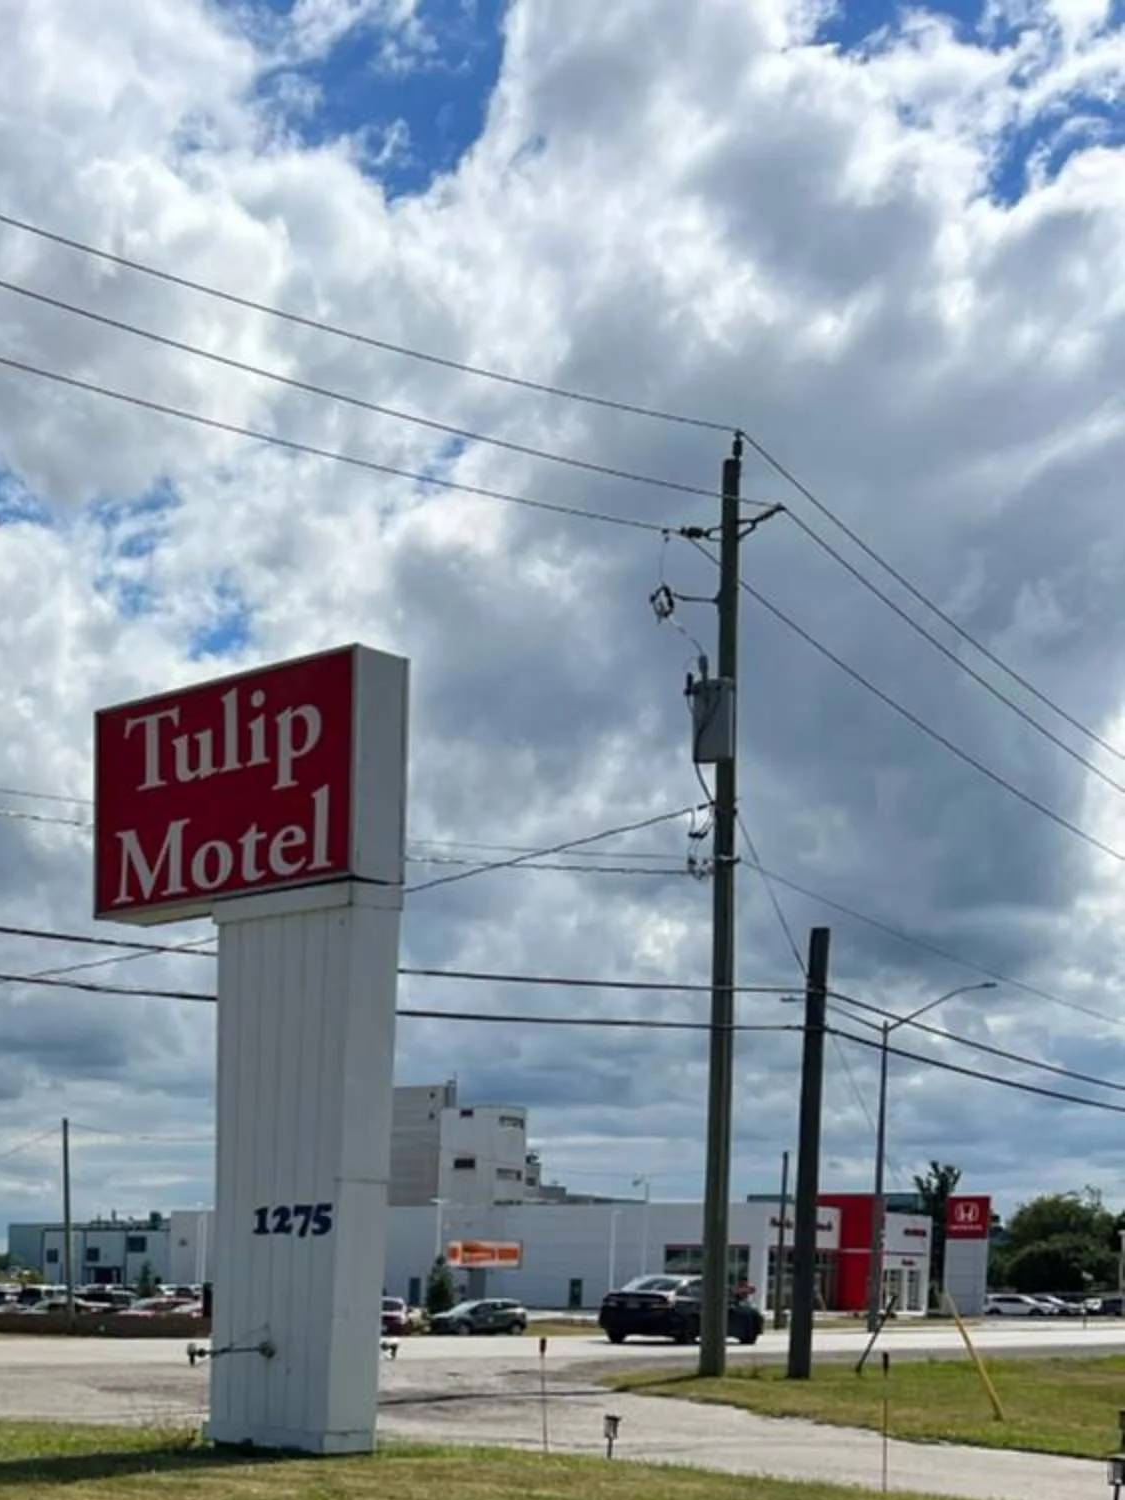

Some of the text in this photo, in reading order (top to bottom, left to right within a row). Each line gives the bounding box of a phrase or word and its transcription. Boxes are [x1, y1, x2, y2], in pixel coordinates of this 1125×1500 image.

[124, 687, 322, 791] Tulip
[113, 784, 332, 904] Motel
[253, 1203, 332, 1237] 1275
